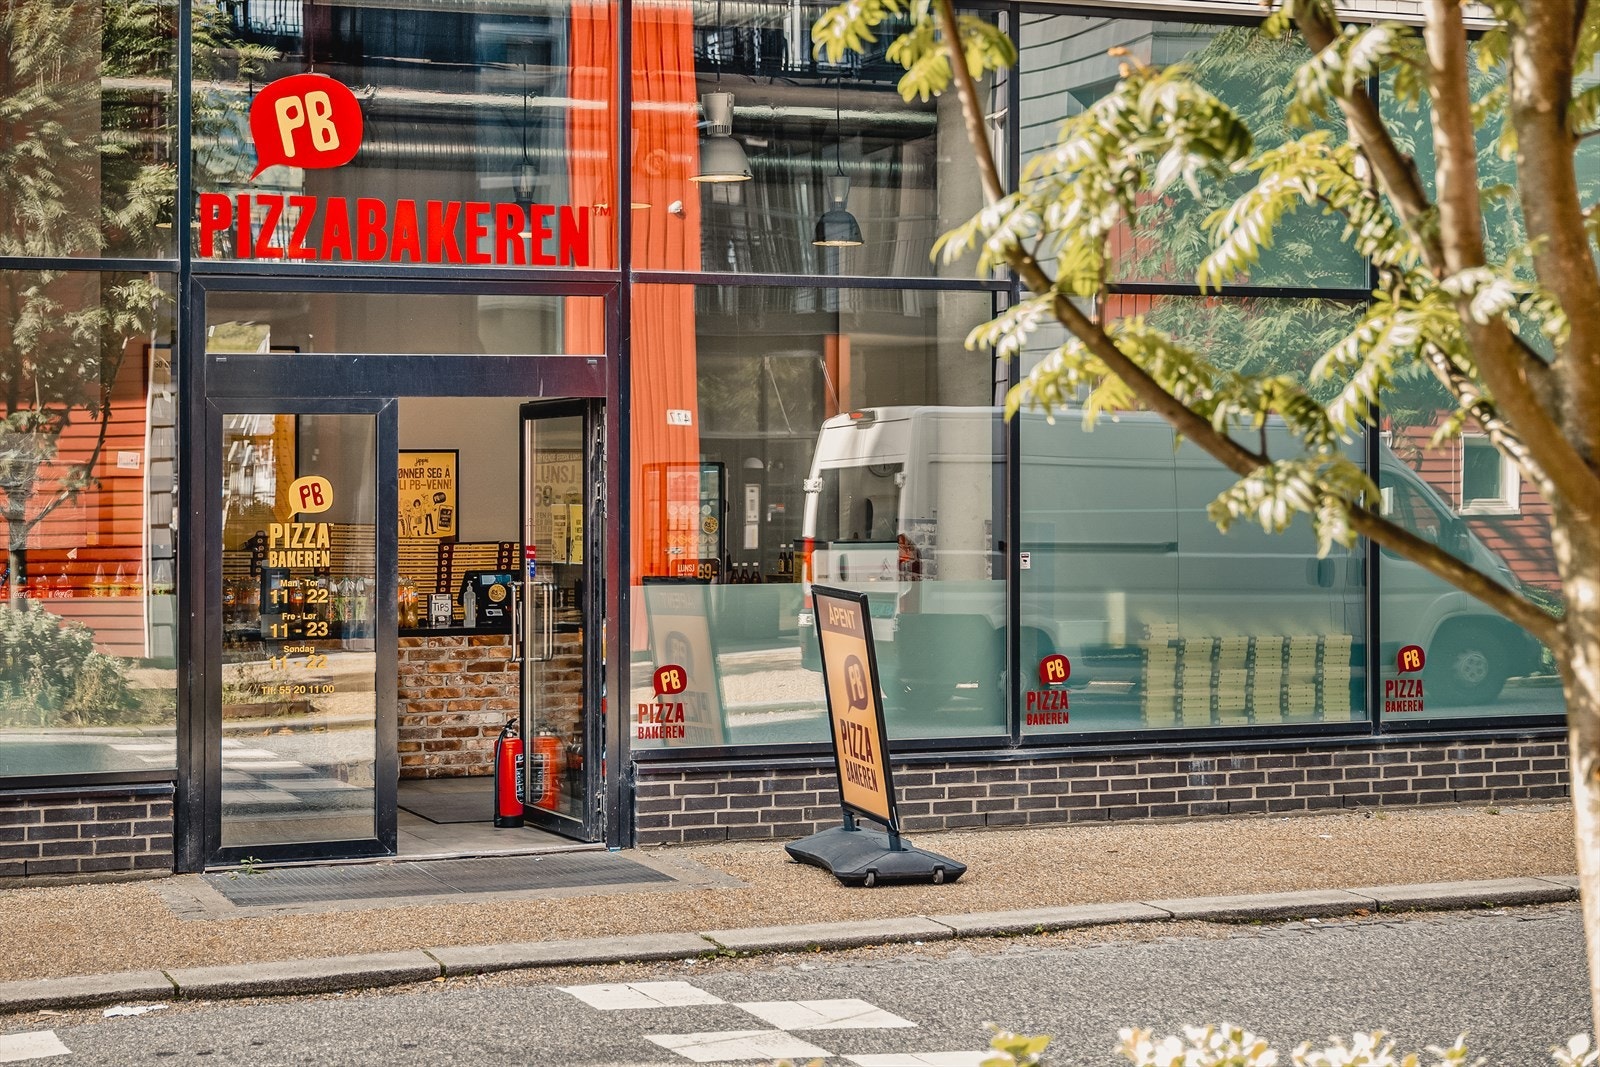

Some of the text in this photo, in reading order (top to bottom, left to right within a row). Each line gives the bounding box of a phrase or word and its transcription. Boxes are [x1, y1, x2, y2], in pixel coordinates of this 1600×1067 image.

[274, 90, 340, 158] PB
[199, 193, 590, 267] PIZZABAKEREN
[397, 468, 425, 479] ØNNER
[427, 468, 442, 478] SEG
[399, 480, 407, 490] LI
[299, 482, 324, 509] PB
[269, 523, 330, 549] PIZZA
[269, 550, 330, 568] BAKEREN
[677, 564, 695, 573] LUNSJ
[280, 579, 297, 587] Man
[305, 579, 319, 587] Tor
[270, 589, 288, 604] 11
[306, 588, 329, 604] 22
[282, 612, 296, 620] Fre
[303, 612, 317, 620] Lør
[270, 623, 288, 638] 11
[306, 621, 329, 637] 23
[283, 645, 315, 653] Søndag
[270, 655, 287, 670] 11
[306, 654, 328, 669] 22
[1403, 649, 1421, 670] PB
[1046, 659, 1065, 680] PB
[261, 684, 335, 695] Tlf: 55 20 11 00
[660, 669, 681, 692] PB
[847, 663, 865, 701] PB
[1385, 679, 1424, 699] PIZZA
[1026, 690, 1069, 711] PIZZA
[1385, 700, 1424, 713] BAKEREN
[637, 703, 685, 724] PIZZA
[1026, 712, 1069, 726] BAKEREN
[637, 726, 685, 740] BAKEREN
[840, 718, 874, 765] PIZZA
[845, 758, 879, 793] BAKEREN
